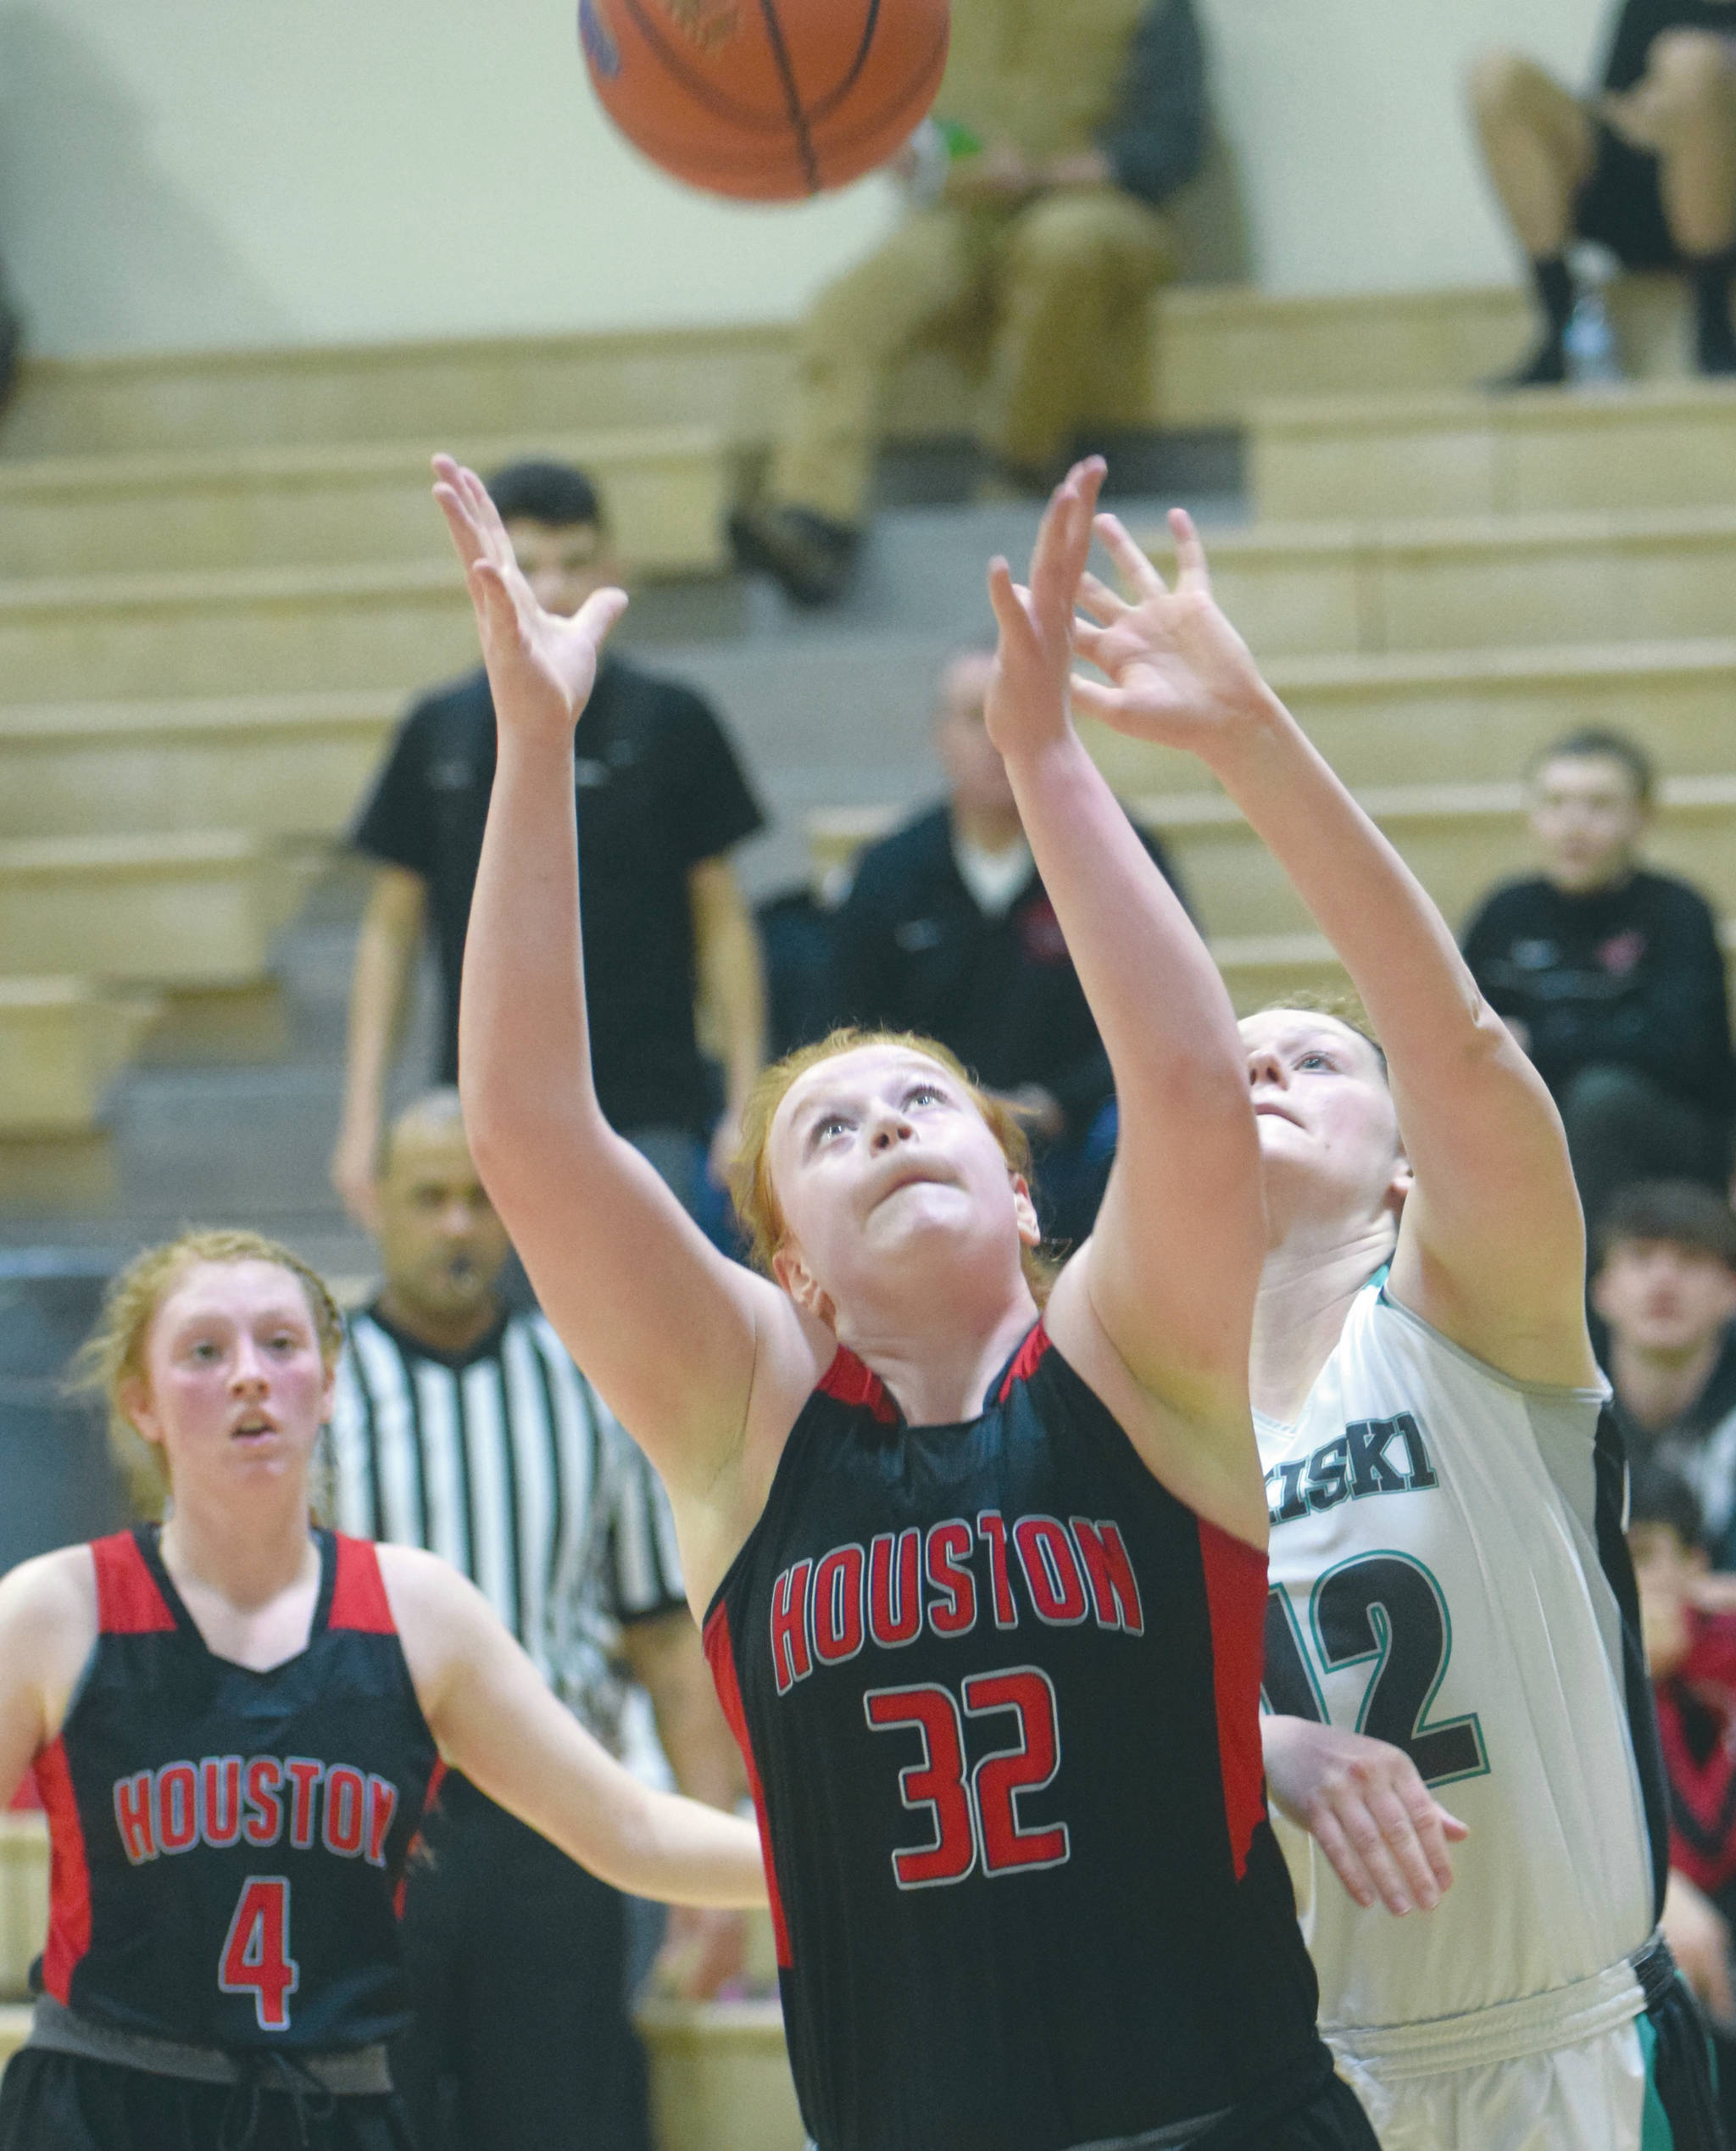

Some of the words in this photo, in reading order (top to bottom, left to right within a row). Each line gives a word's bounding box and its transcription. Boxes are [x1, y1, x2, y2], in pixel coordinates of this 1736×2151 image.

[1264, 1410, 1439, 1527] ISKI
[770, 1509, 1144, 1696] HOUSTON
[863, 1664, 1070, 1890] 32
[218, 1875, 299, 2031] 4
